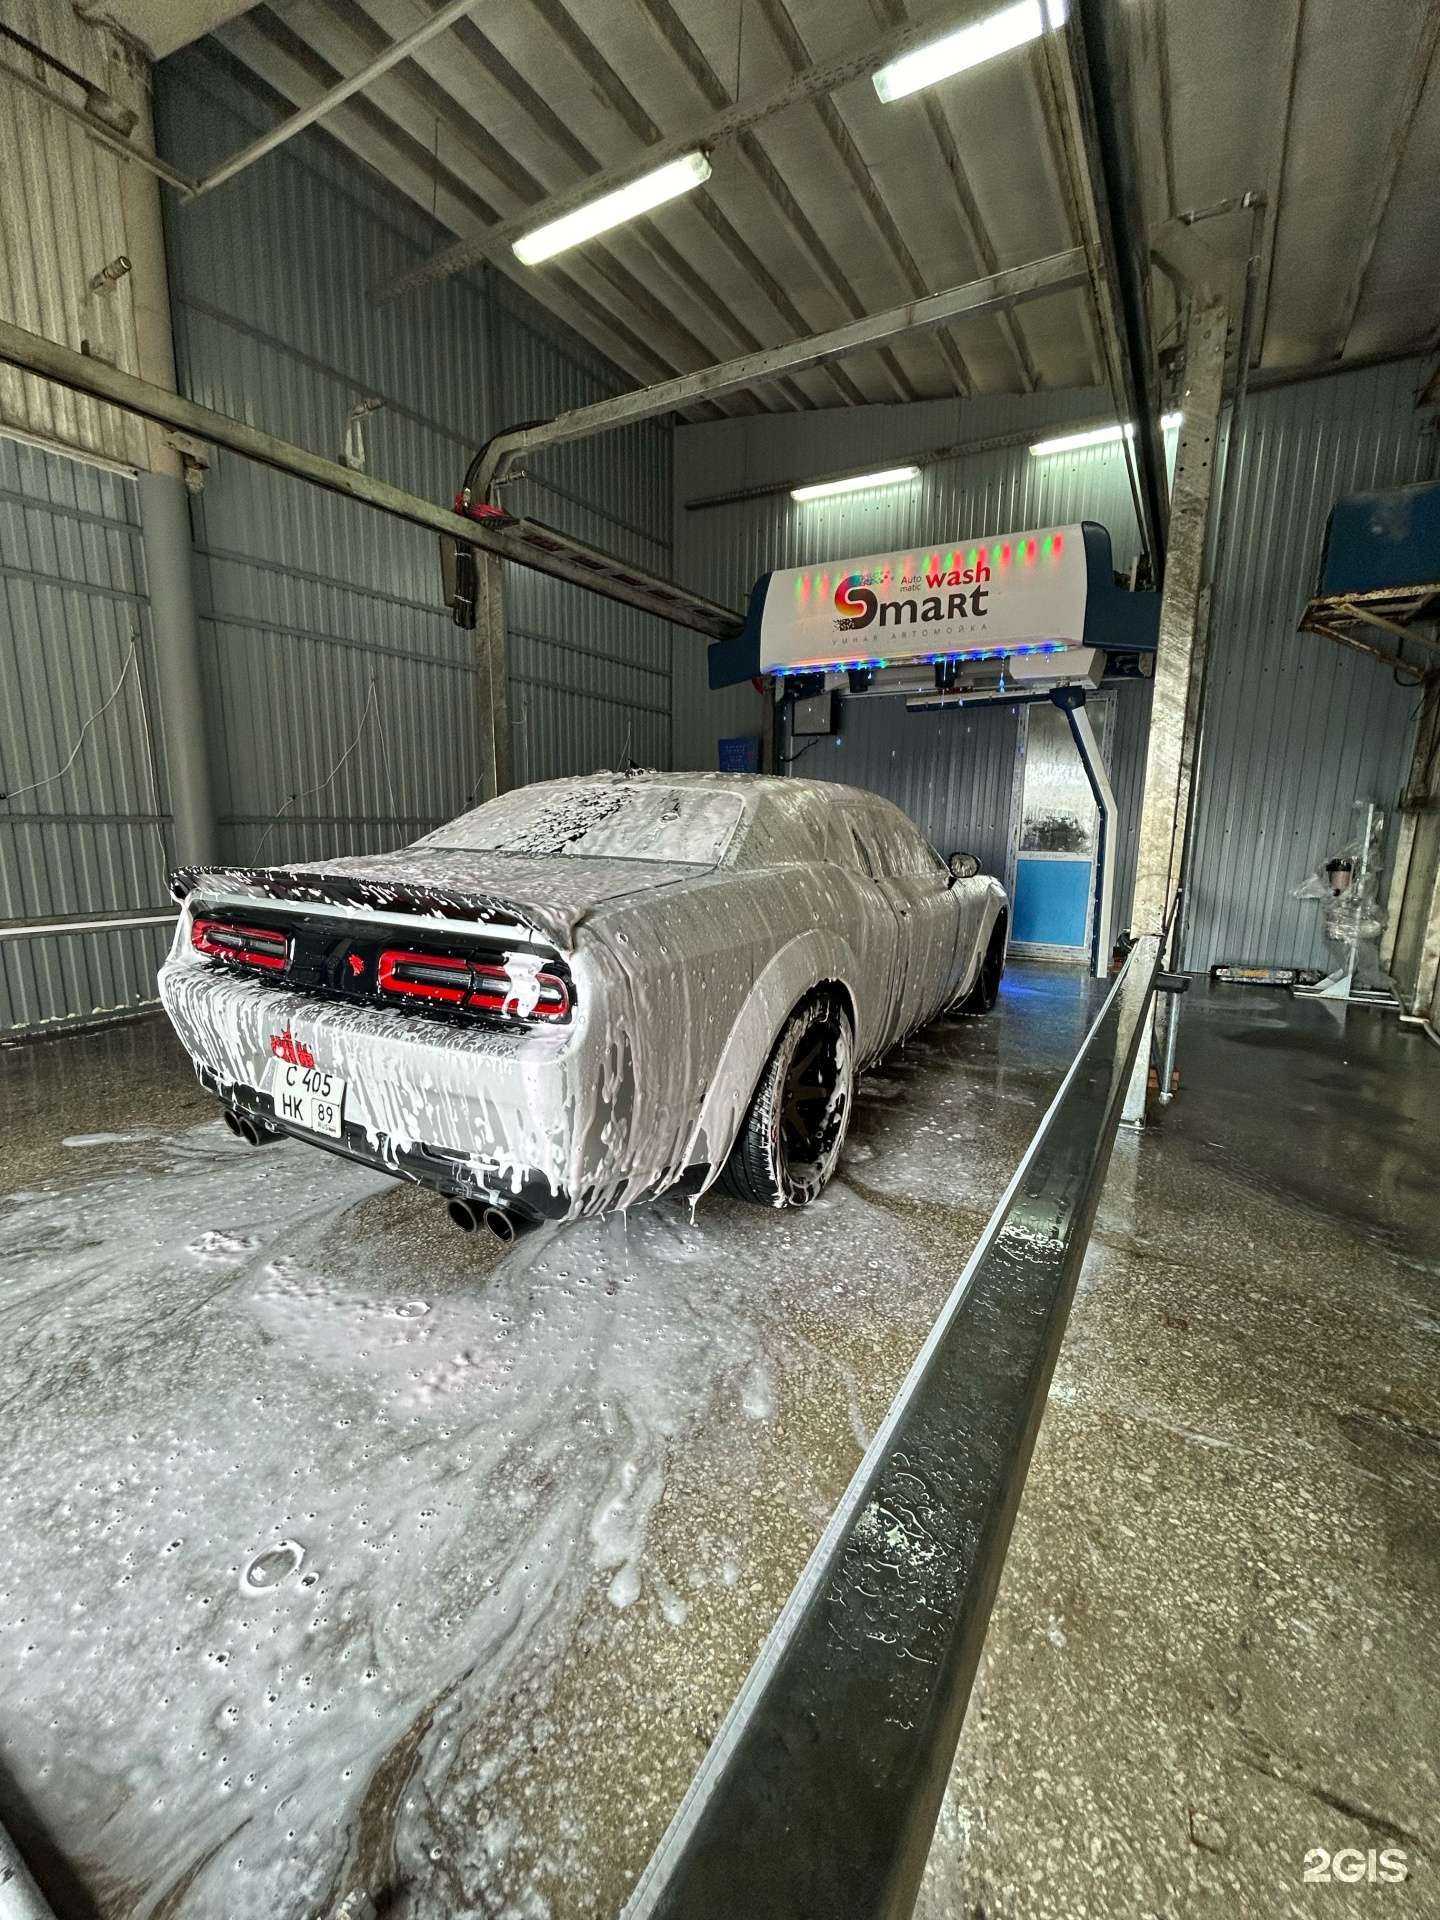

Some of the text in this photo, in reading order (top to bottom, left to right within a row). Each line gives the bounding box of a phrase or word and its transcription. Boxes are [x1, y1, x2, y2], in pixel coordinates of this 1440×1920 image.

[901, 576, 921, 585] Auto
[925, 560, 991, 589] wash
[900, 584, 921, 593] matic
[302, 1068, 333, 1097] 405
[317, 1103, 333, 1124] 89
